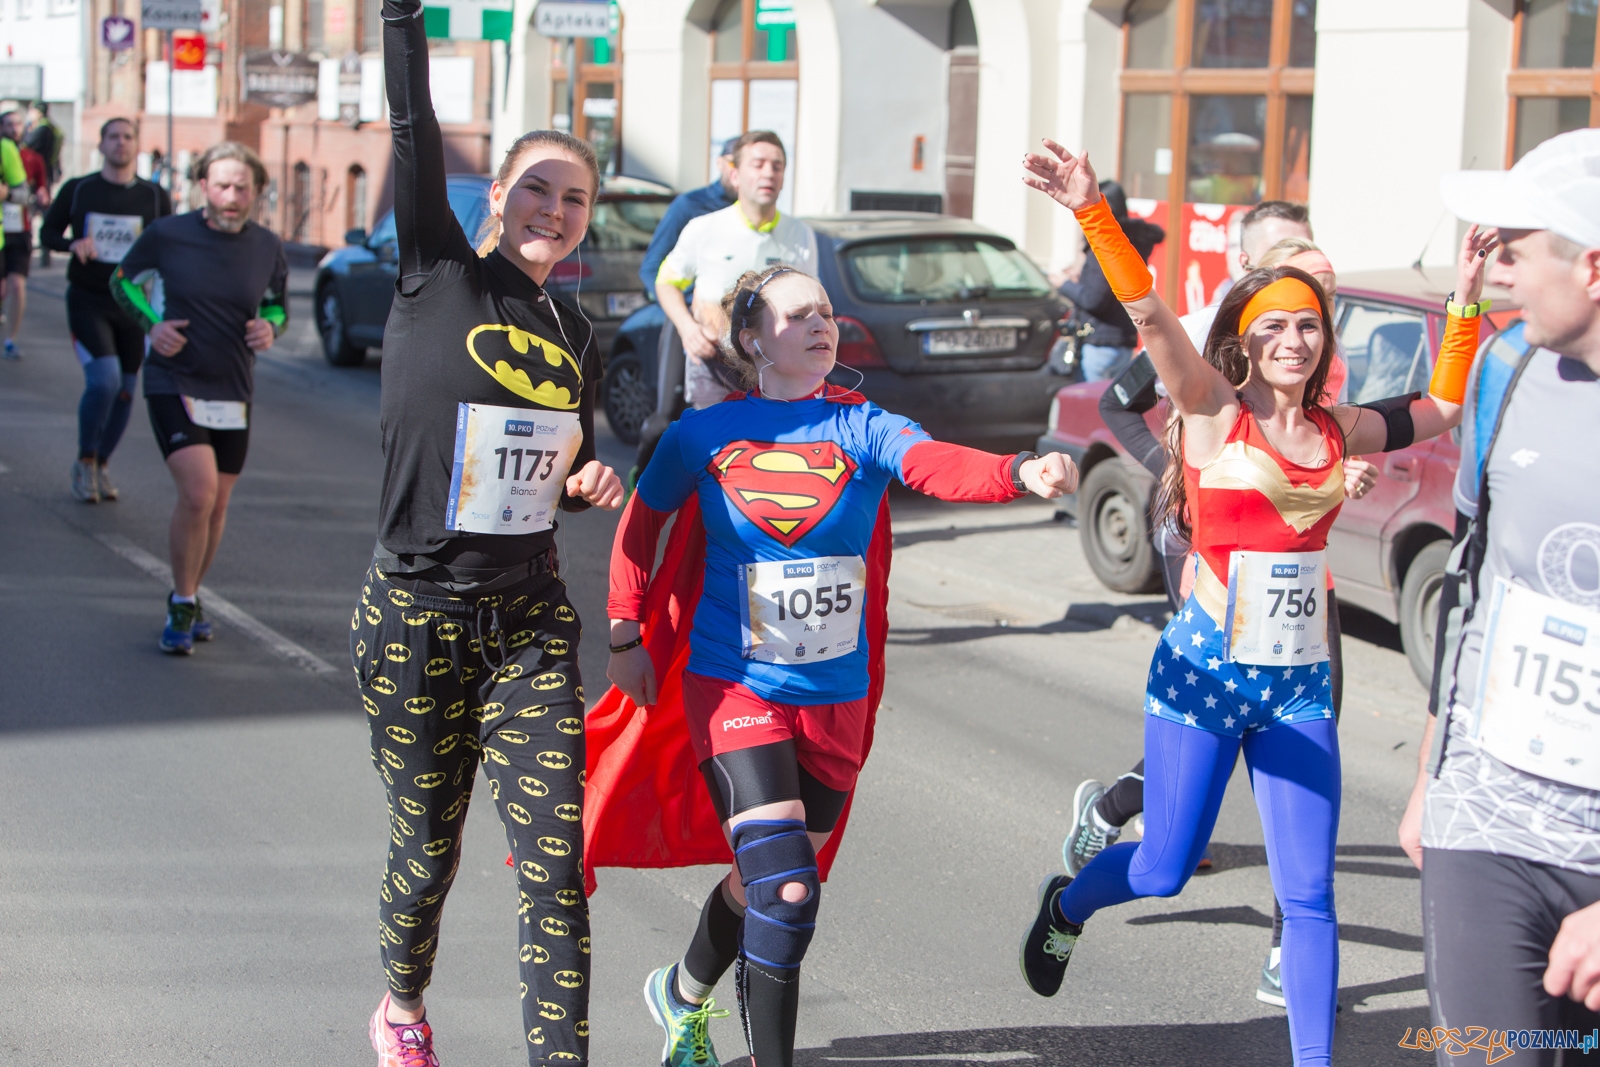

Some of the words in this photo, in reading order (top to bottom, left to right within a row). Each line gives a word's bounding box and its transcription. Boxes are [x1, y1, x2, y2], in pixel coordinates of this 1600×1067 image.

[542, 11, 605, 30] Apteka
[507, 424, 517, 432] 10.
[517, 425, 532, 433] PKO
[494, 447, 559, 482] 1173
[510, 486, 537, 496] Bianca
[786, 567, 796, 575] 10.
[796, 566, 812, 574] PKO
[1274, 567, 1283, 575] 10.
[1283, 567, 1297, 575] PKO
[771, 583, 852, 621] 1055
[1267, 587, 1317, 618] 756
[803, 623, 827, 632] Anna
[1281, 623, 1305, 631] Marta
[1513, 645, 1600, 715] 1153
[1544, 709, 1593, 732] Marcin
